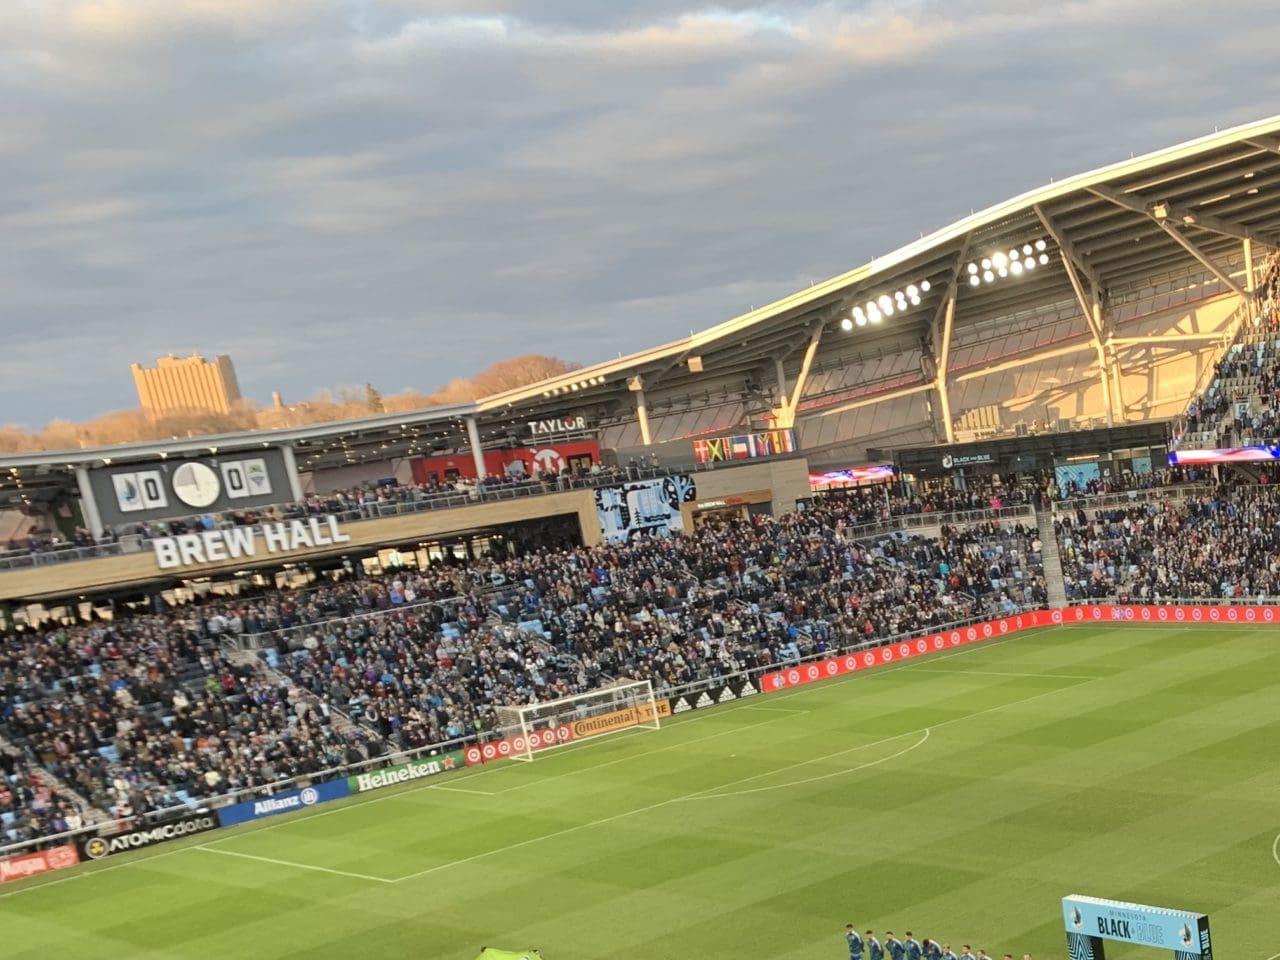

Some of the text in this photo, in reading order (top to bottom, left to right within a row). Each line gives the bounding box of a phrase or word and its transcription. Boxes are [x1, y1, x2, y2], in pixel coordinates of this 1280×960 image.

[527, 416, 586, 435] TAYLOR
[145, 478, 159, 501] 0
[228, 468, 243, 491] 0
[152, 515, 350, 570] BREW HALL
[574, 704, 668, 737] Continental TIRE
[356, 759, 442, 792] Heineken
[254, 794, 300, 815] Allianz
[108, 816, 215, 853] ATOMICdata
[1097, 916, 1131, 938] BLACK
